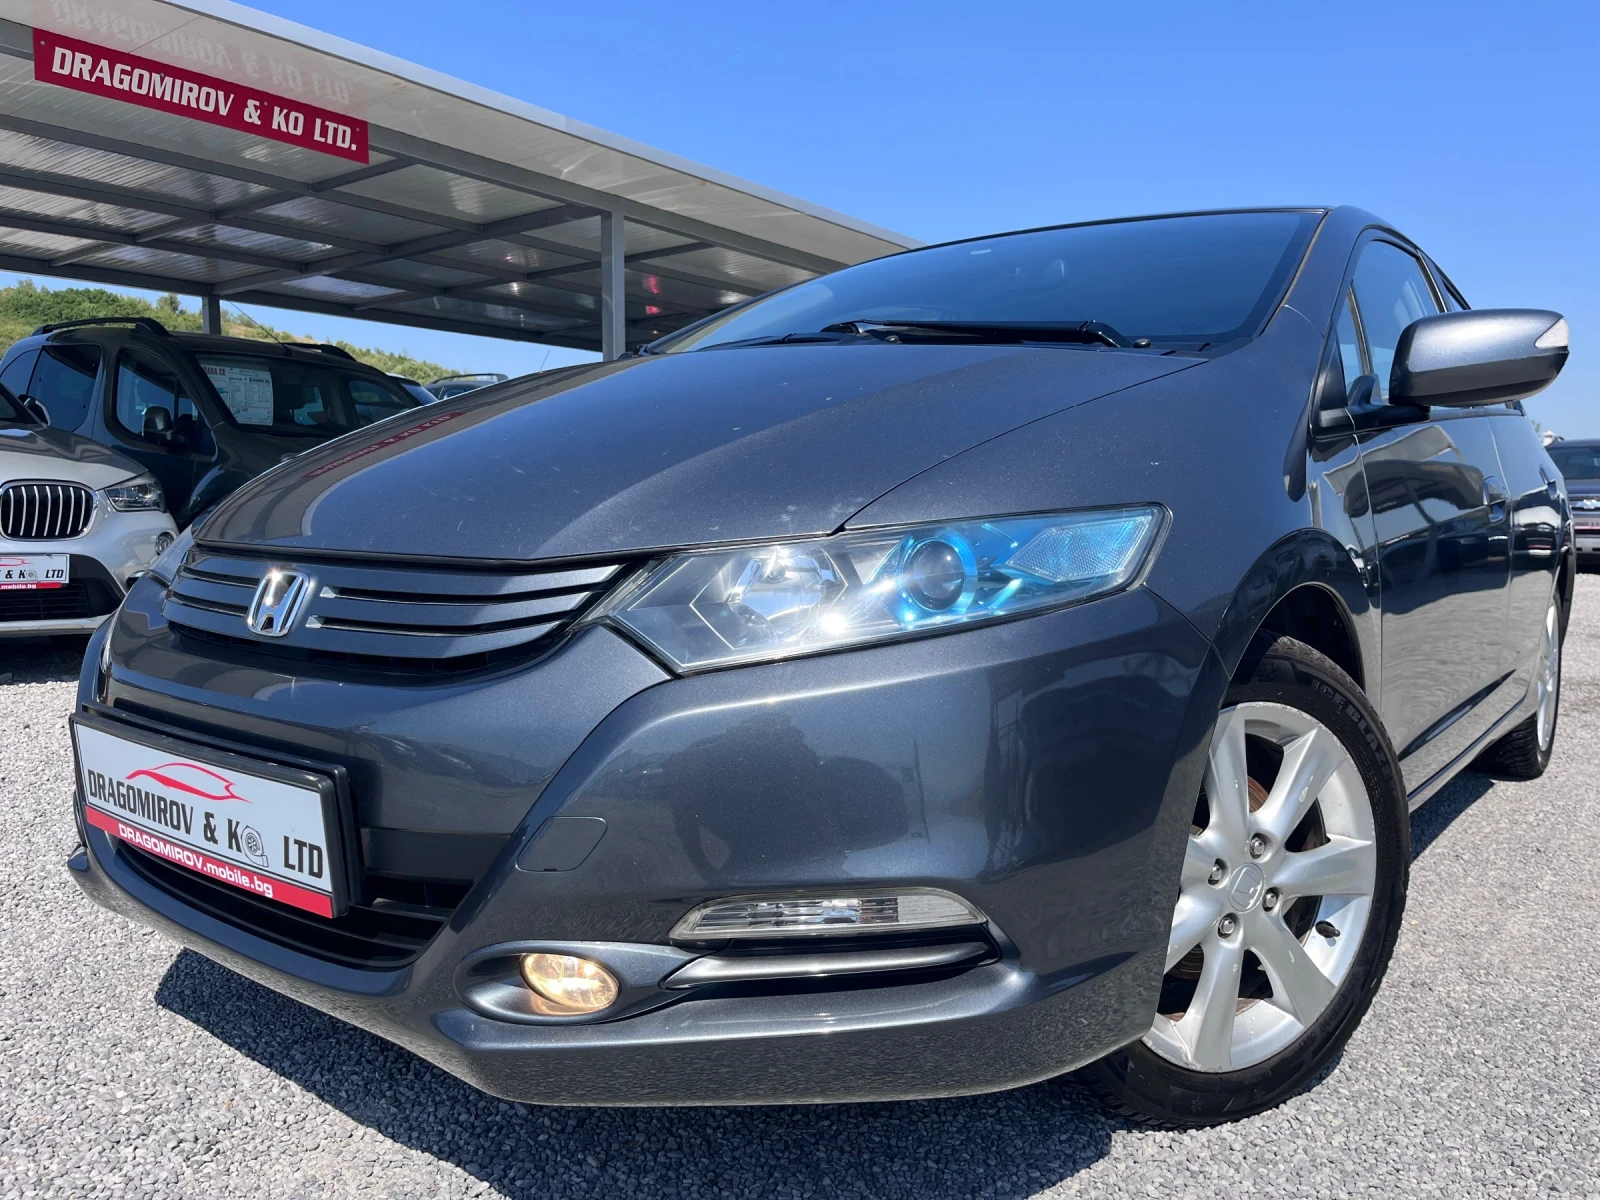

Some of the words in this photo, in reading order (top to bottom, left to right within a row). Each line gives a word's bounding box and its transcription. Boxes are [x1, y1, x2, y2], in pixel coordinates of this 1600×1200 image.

[52, 46, 234, 117] DRAGOMIROV
[243, 99, 261, 126] &
[271, 106, 304, 136] KO
[313, 117, 357, 151] LTD.
[5, 570, 14, 579] &
[45, 569, 64, 579] LTD
[87, 769, 194, 835] DRAGOMIROV
[203, 811, 218, 845] &
[283, 835, 323, 879] LTD
[118, 823, 274, 898] DRAGOMIROV.mobile.bg
